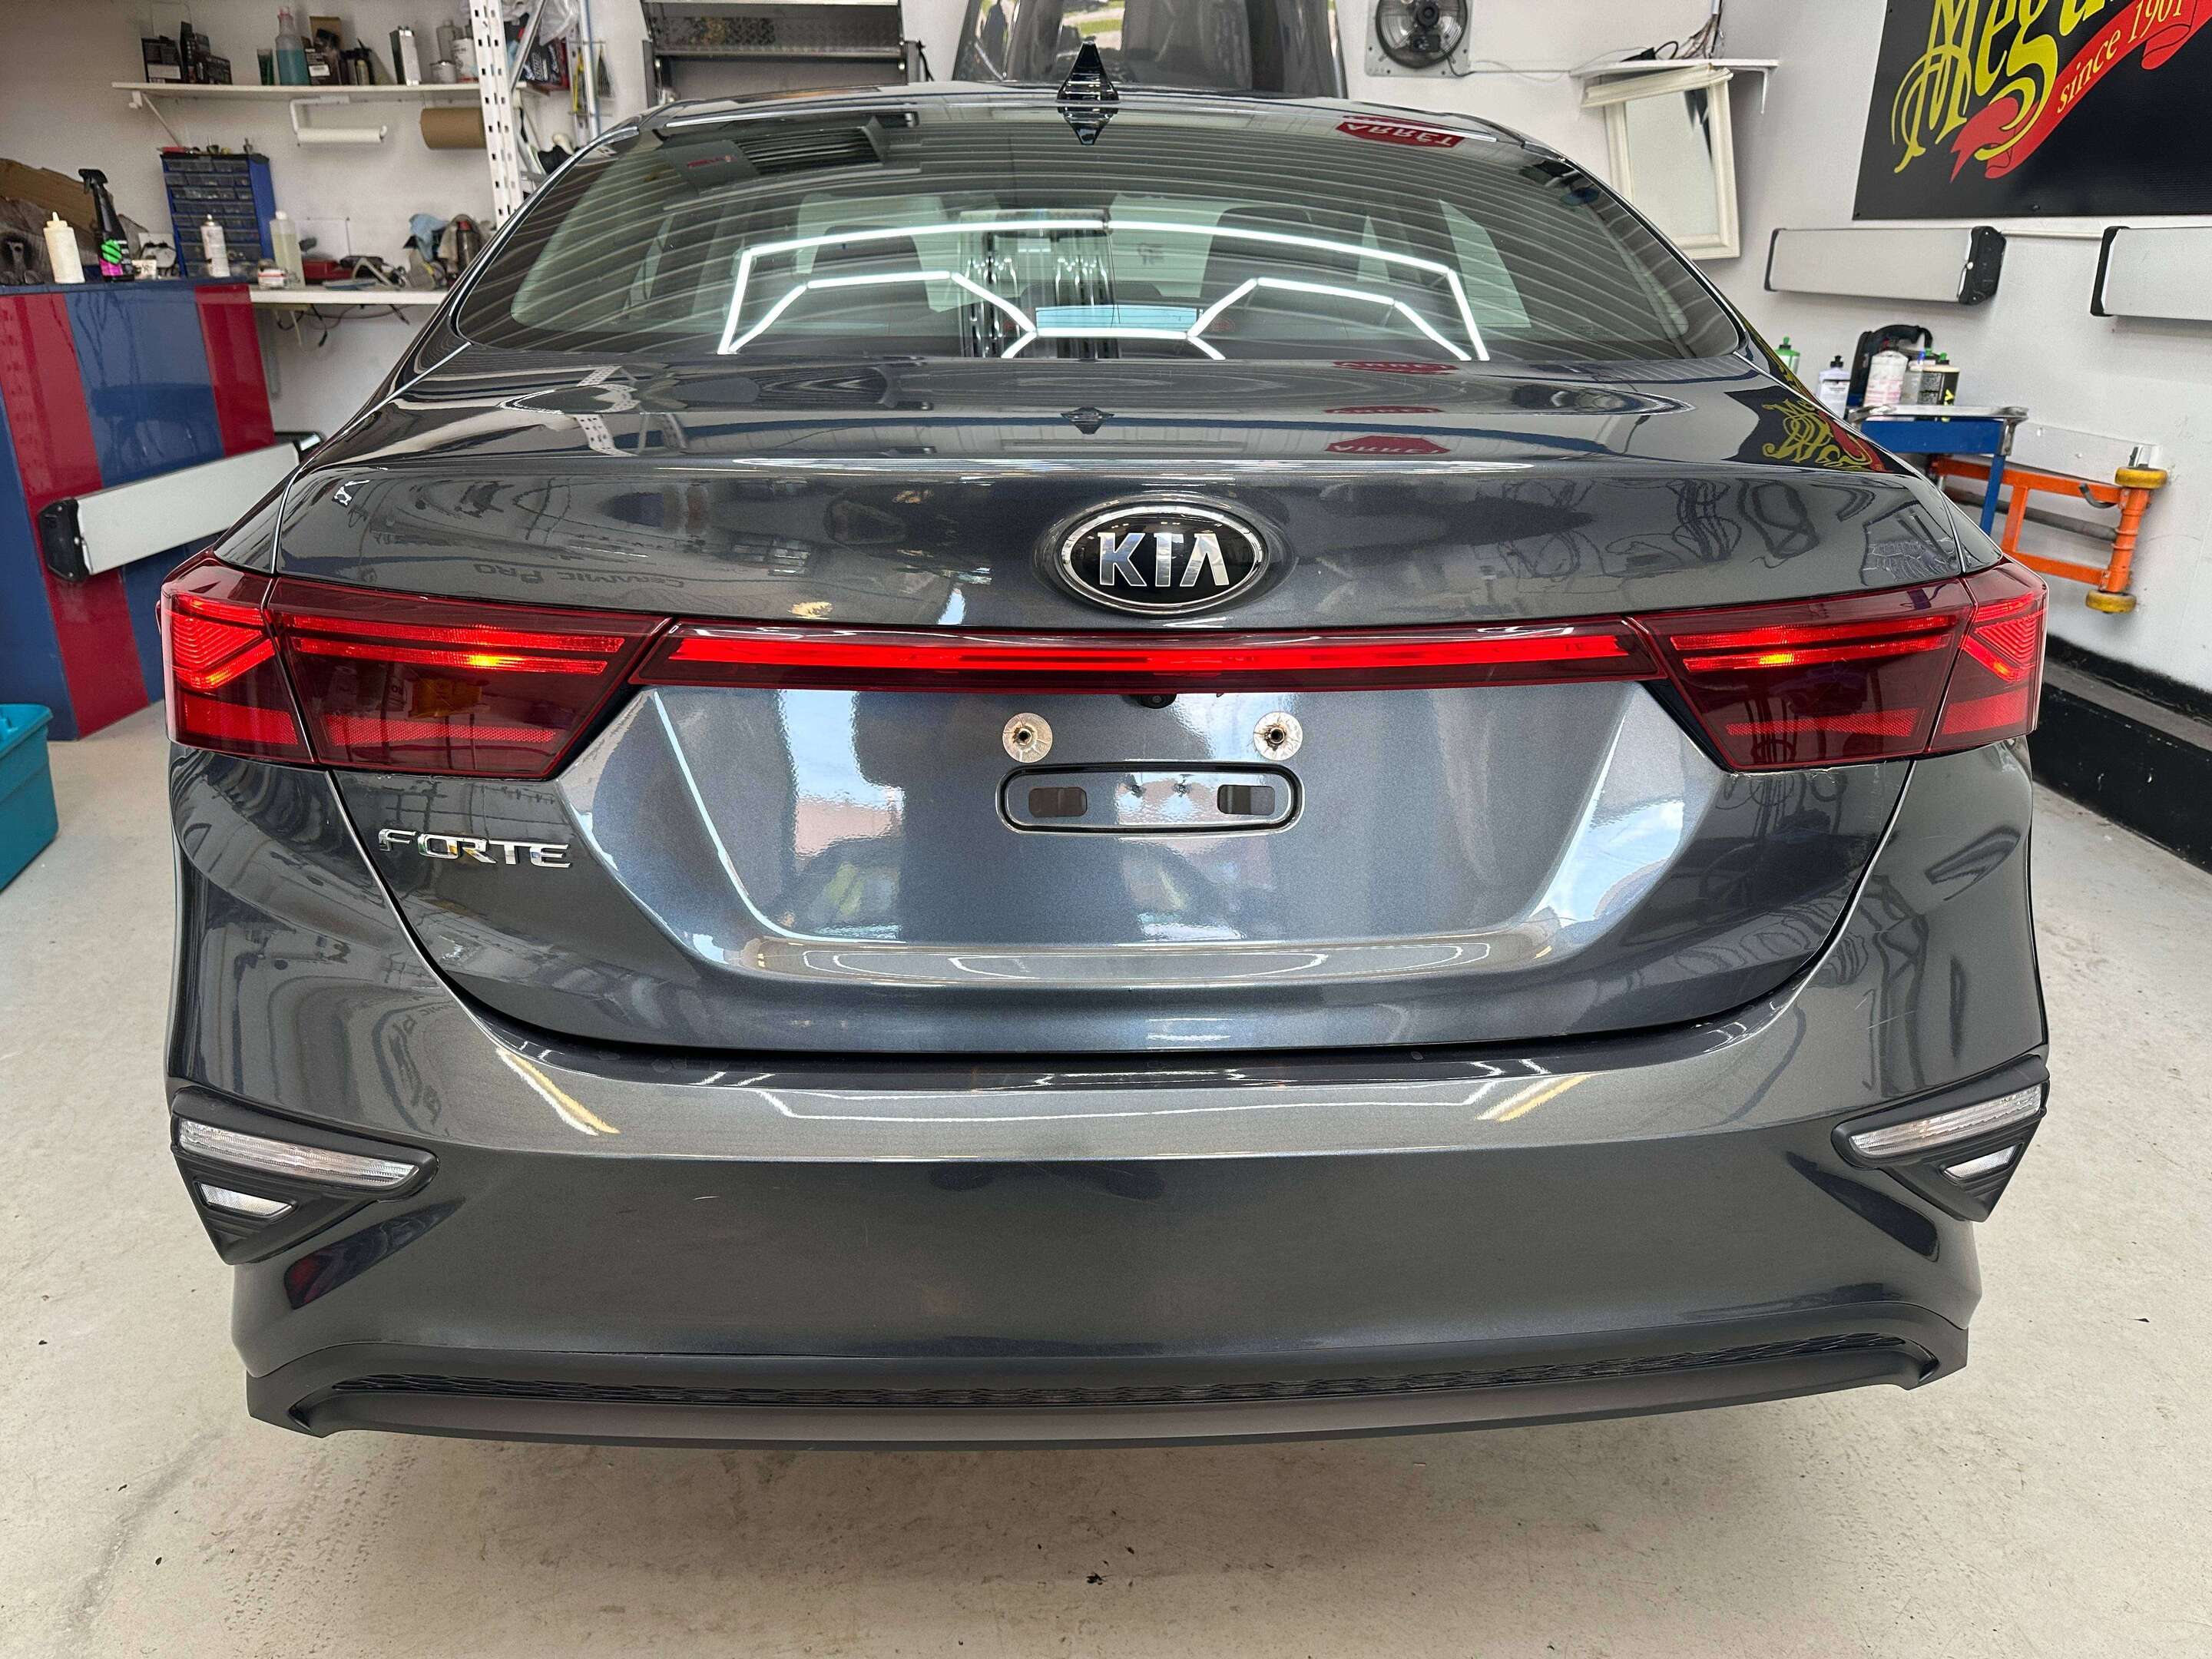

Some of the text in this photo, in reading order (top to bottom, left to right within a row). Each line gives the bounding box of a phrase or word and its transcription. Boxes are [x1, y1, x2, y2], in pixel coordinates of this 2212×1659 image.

[2057, 29, 2121, 114] since
[1097, 532, 1230, 588] KIA
[378, 828, 571, 869] FORTE
